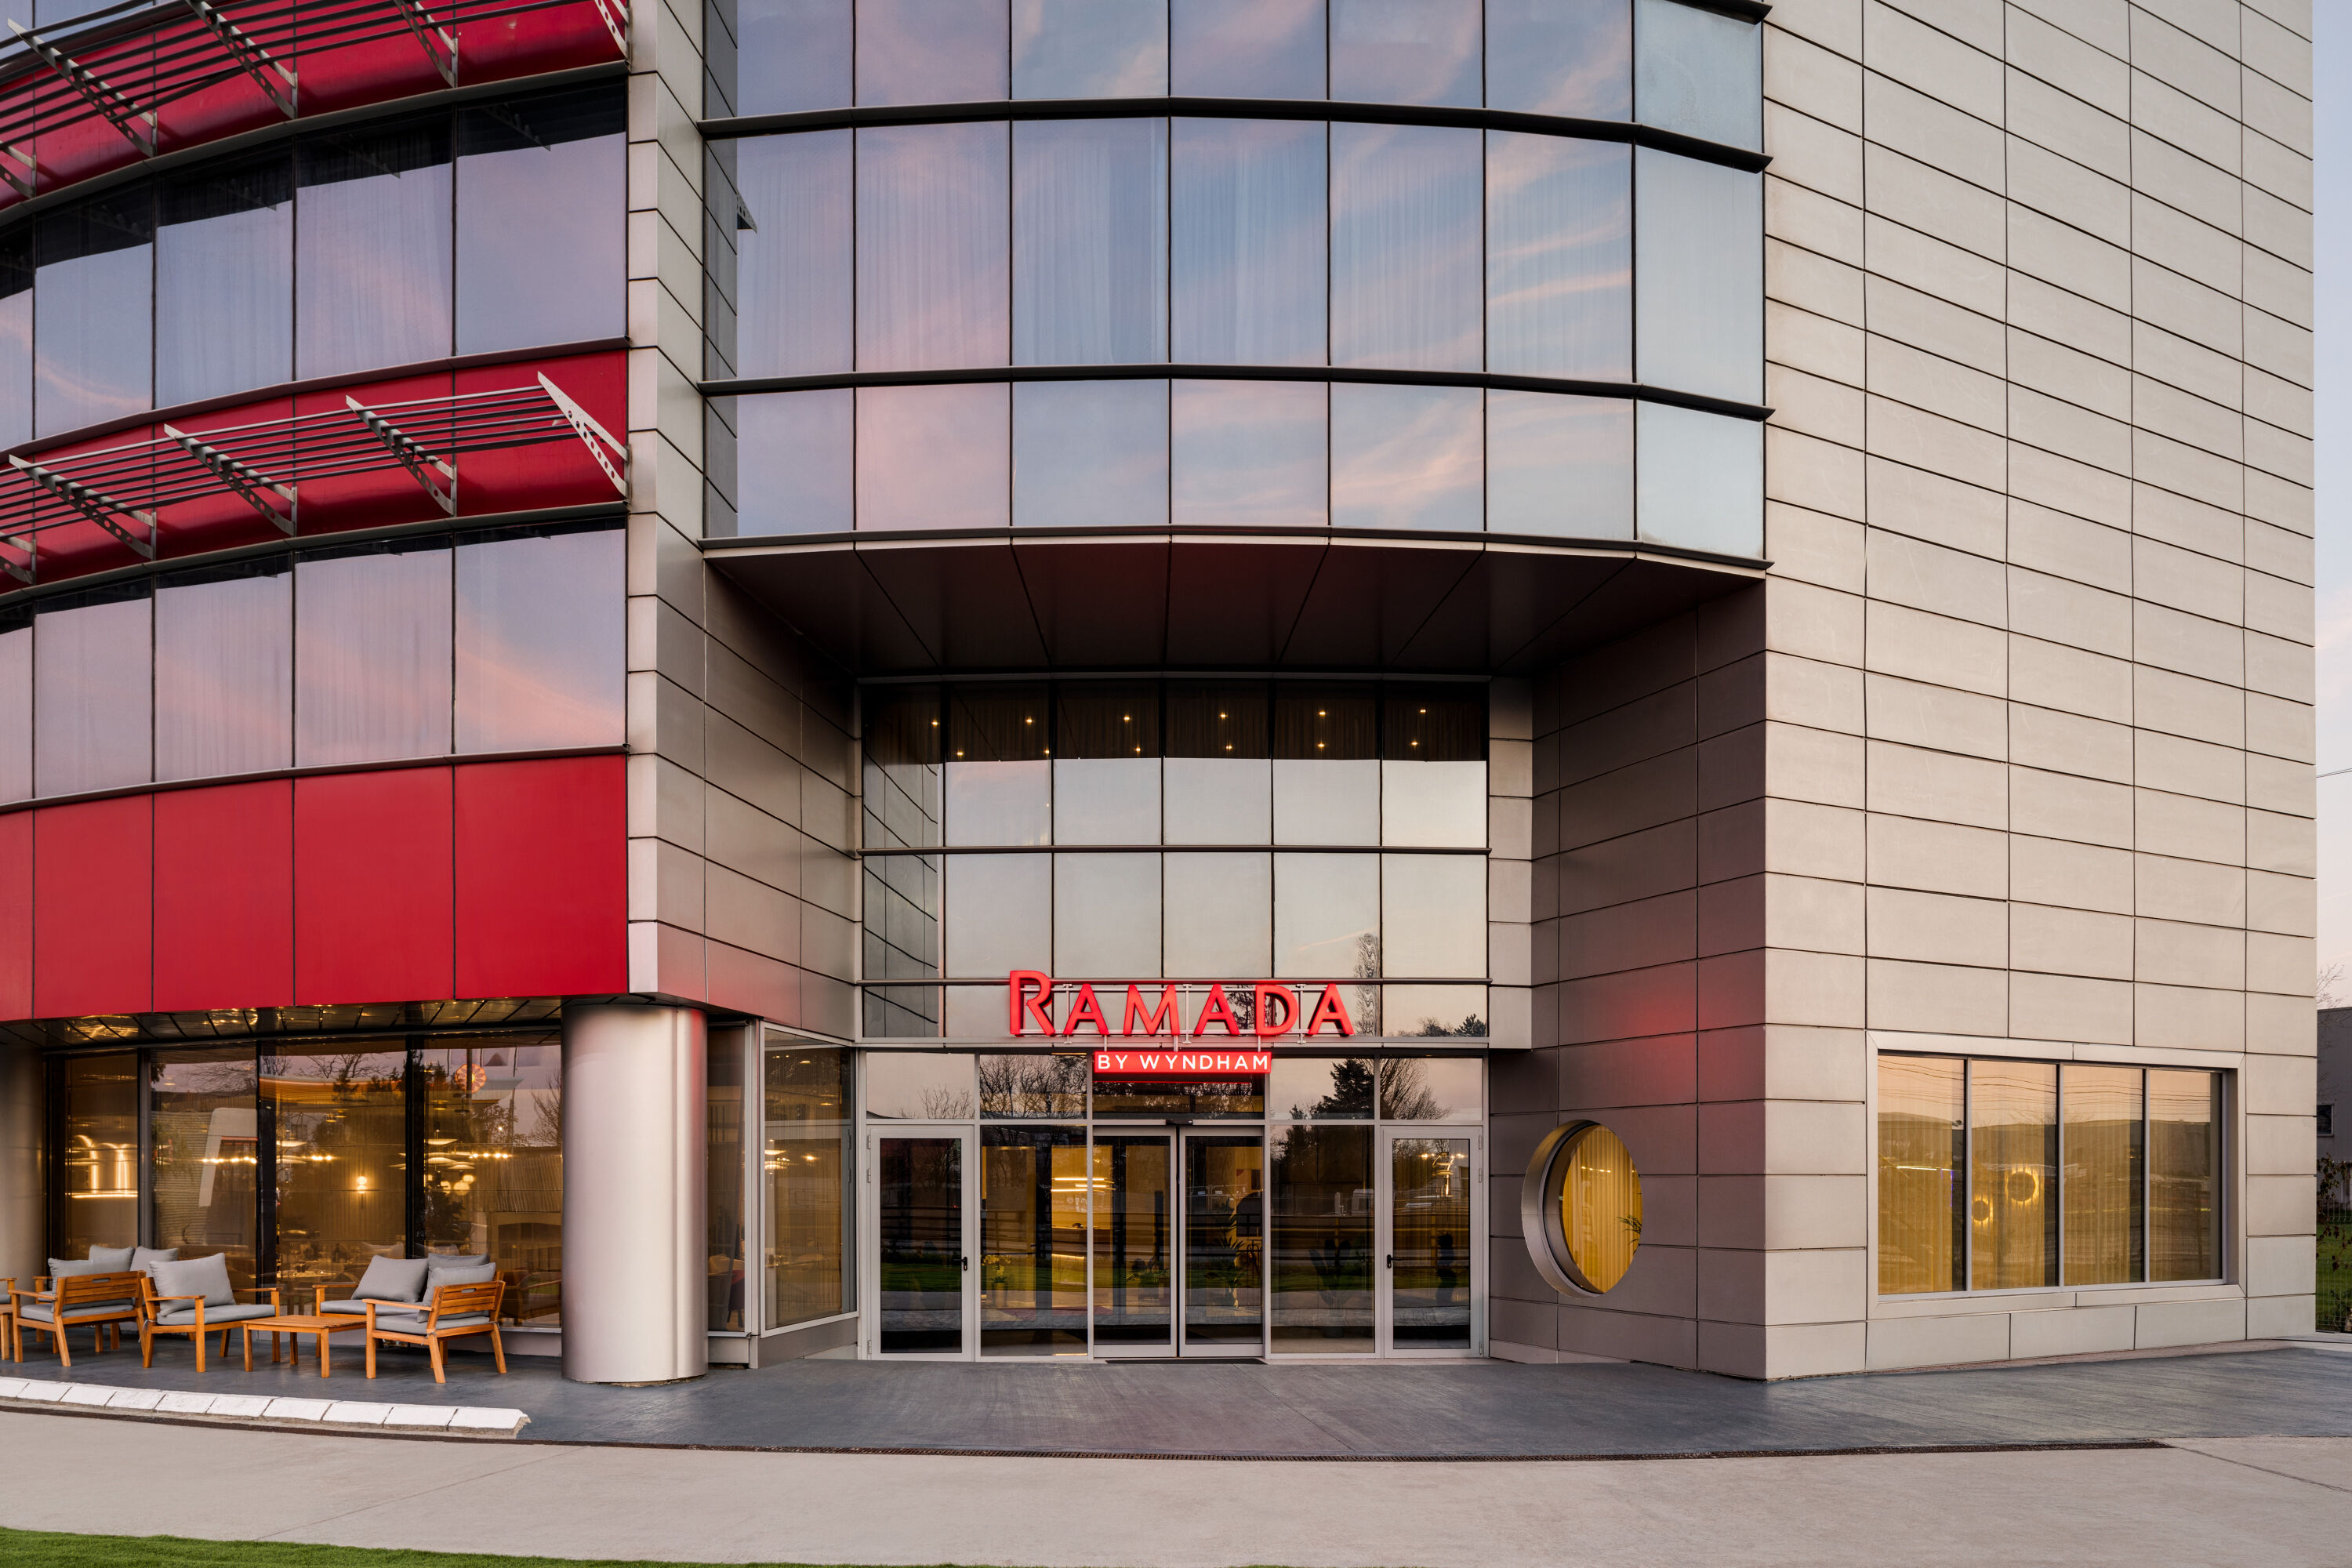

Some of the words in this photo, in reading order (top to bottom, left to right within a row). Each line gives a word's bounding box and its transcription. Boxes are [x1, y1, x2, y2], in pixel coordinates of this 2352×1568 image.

[1009, 970, 1355, 1036] RAMADA
[1098, 1054, 1128, 1070] BY
[1139, 1054, 1269, 1070] WYNDHAM
